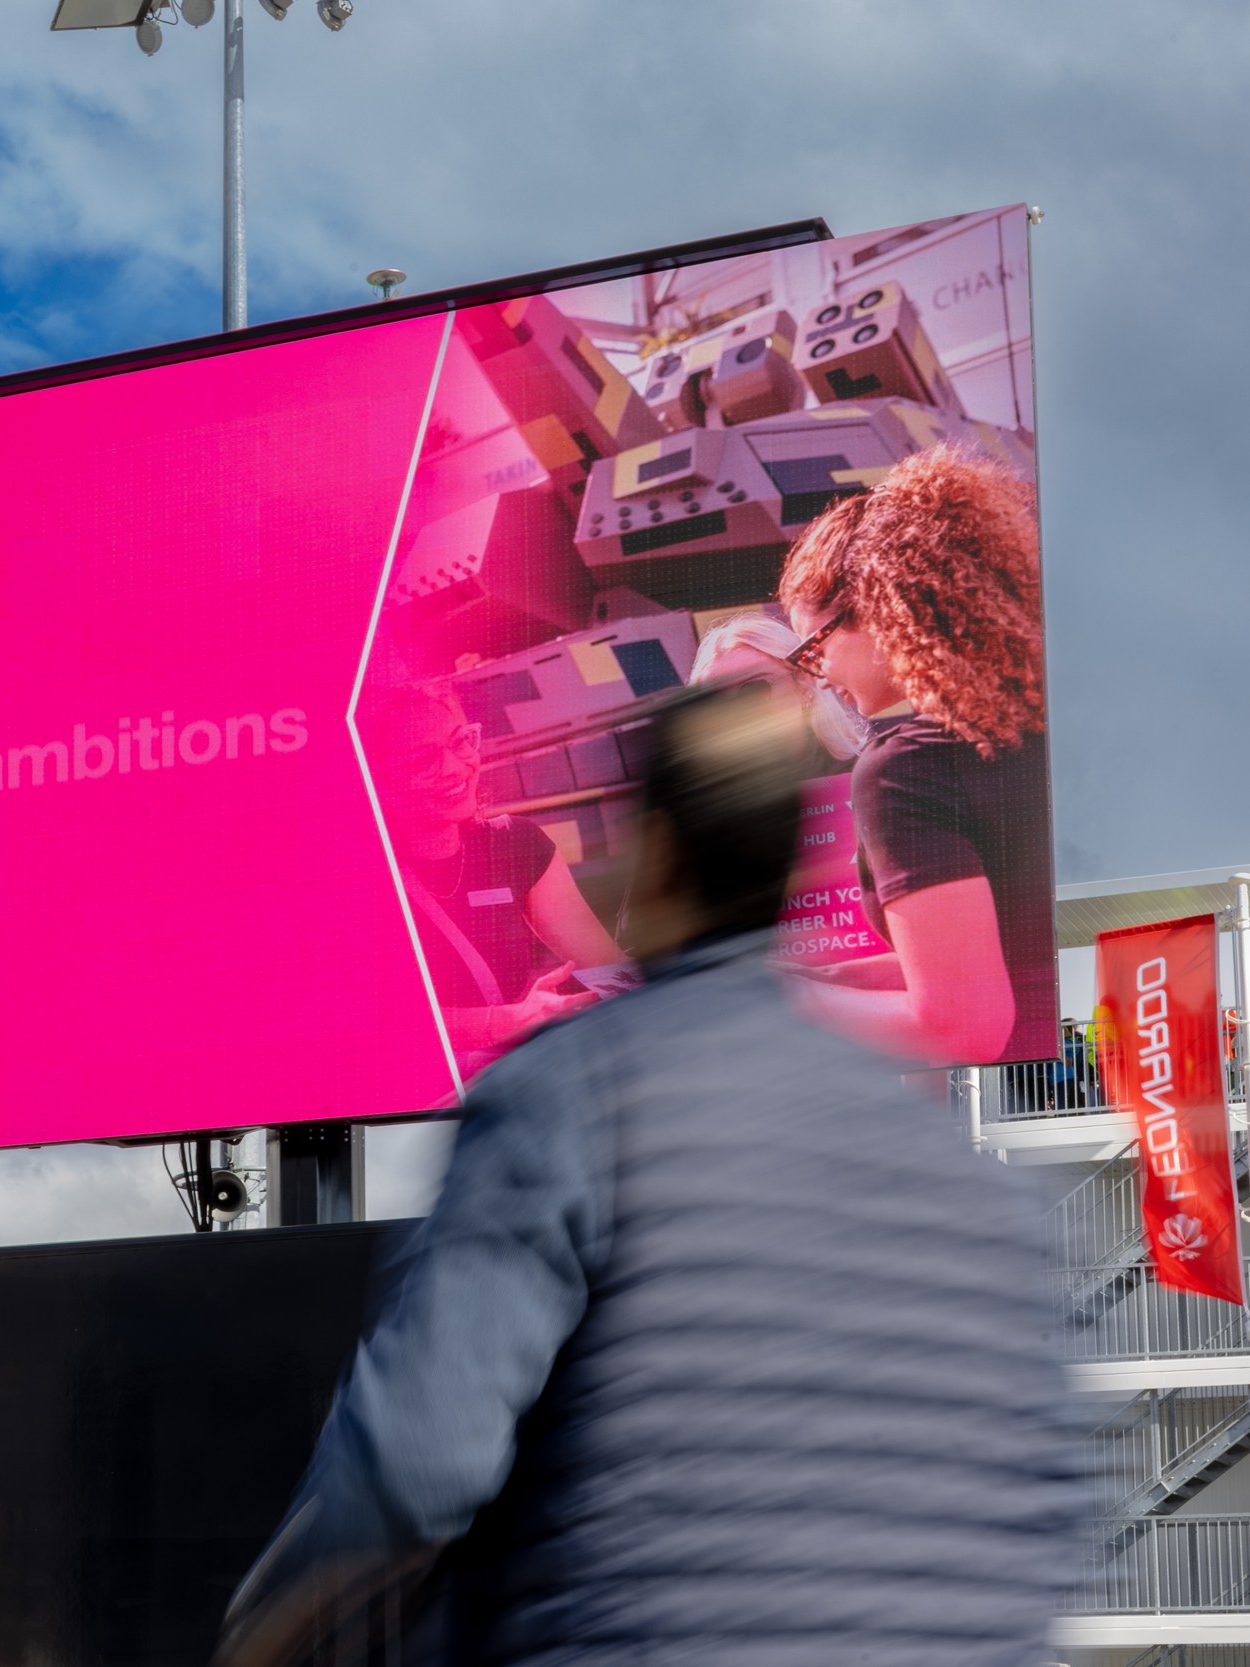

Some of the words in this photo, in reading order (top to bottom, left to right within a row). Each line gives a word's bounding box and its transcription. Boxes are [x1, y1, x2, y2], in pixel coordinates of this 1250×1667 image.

[799, 803, 835, 817] ERLIN
[803, 831, 837, 846] HUB
[779, 891, 831, 912] NCH
[835, 886, 863, 904] YO
[773, 915, 827, 936] REER
[831, 910, 854, 927] IN
